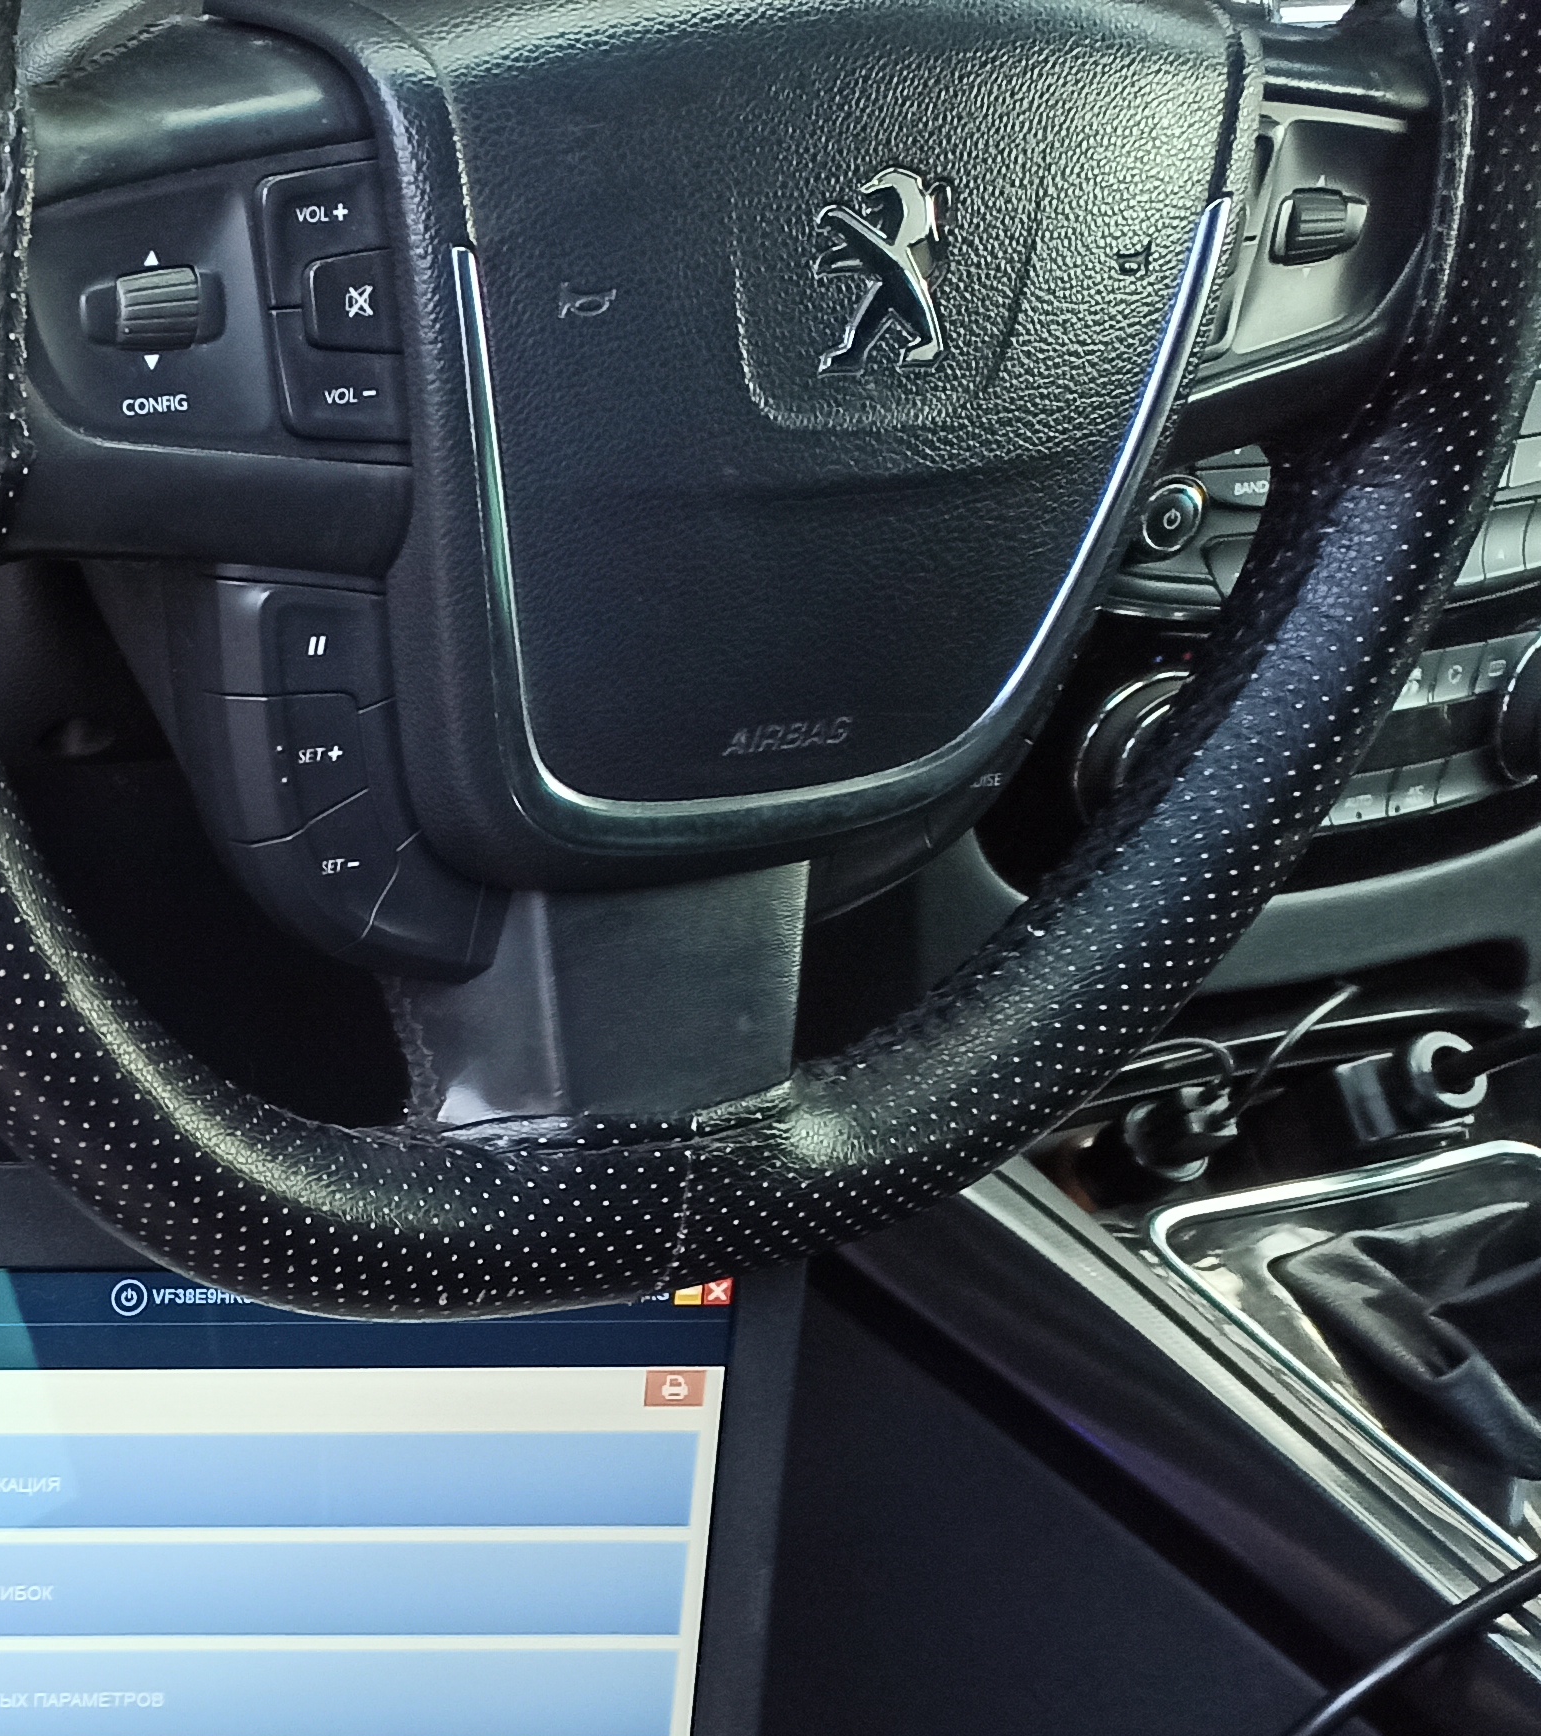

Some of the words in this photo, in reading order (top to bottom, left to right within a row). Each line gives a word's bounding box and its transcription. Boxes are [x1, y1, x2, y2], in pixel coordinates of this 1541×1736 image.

[122, 394, 188, 417] CONFIG
[1234, 480, 1270, 496] BAND
[721, 715, 854, 758] AIRBAG
[34, 1691, 166, 1708] ПАРАМЕТРОВ
